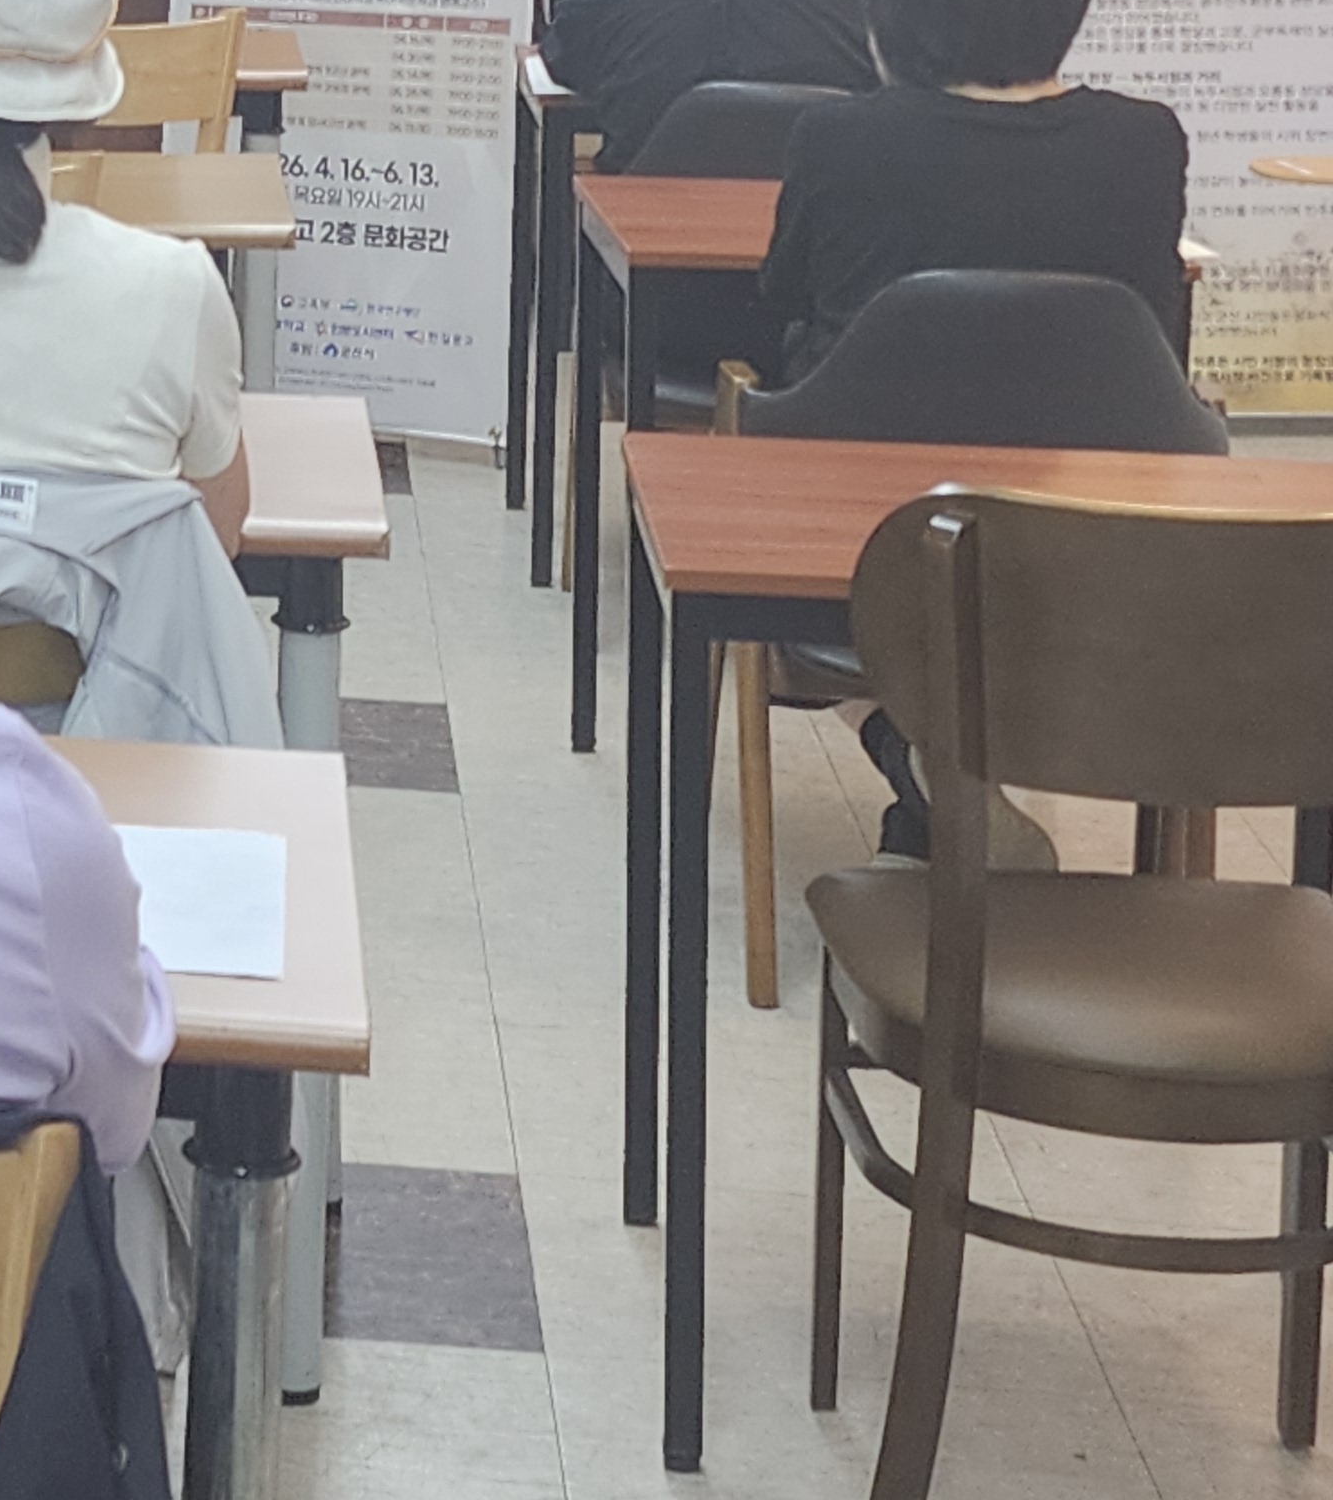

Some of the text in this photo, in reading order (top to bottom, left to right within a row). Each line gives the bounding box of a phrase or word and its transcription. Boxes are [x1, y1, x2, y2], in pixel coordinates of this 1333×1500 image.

[314, 156, 335, 182] 4.
[409, 162, 440, 188] 13.
[321, 220, 357, 247] 2층
[363, 223, 451, 255] 문화공간
